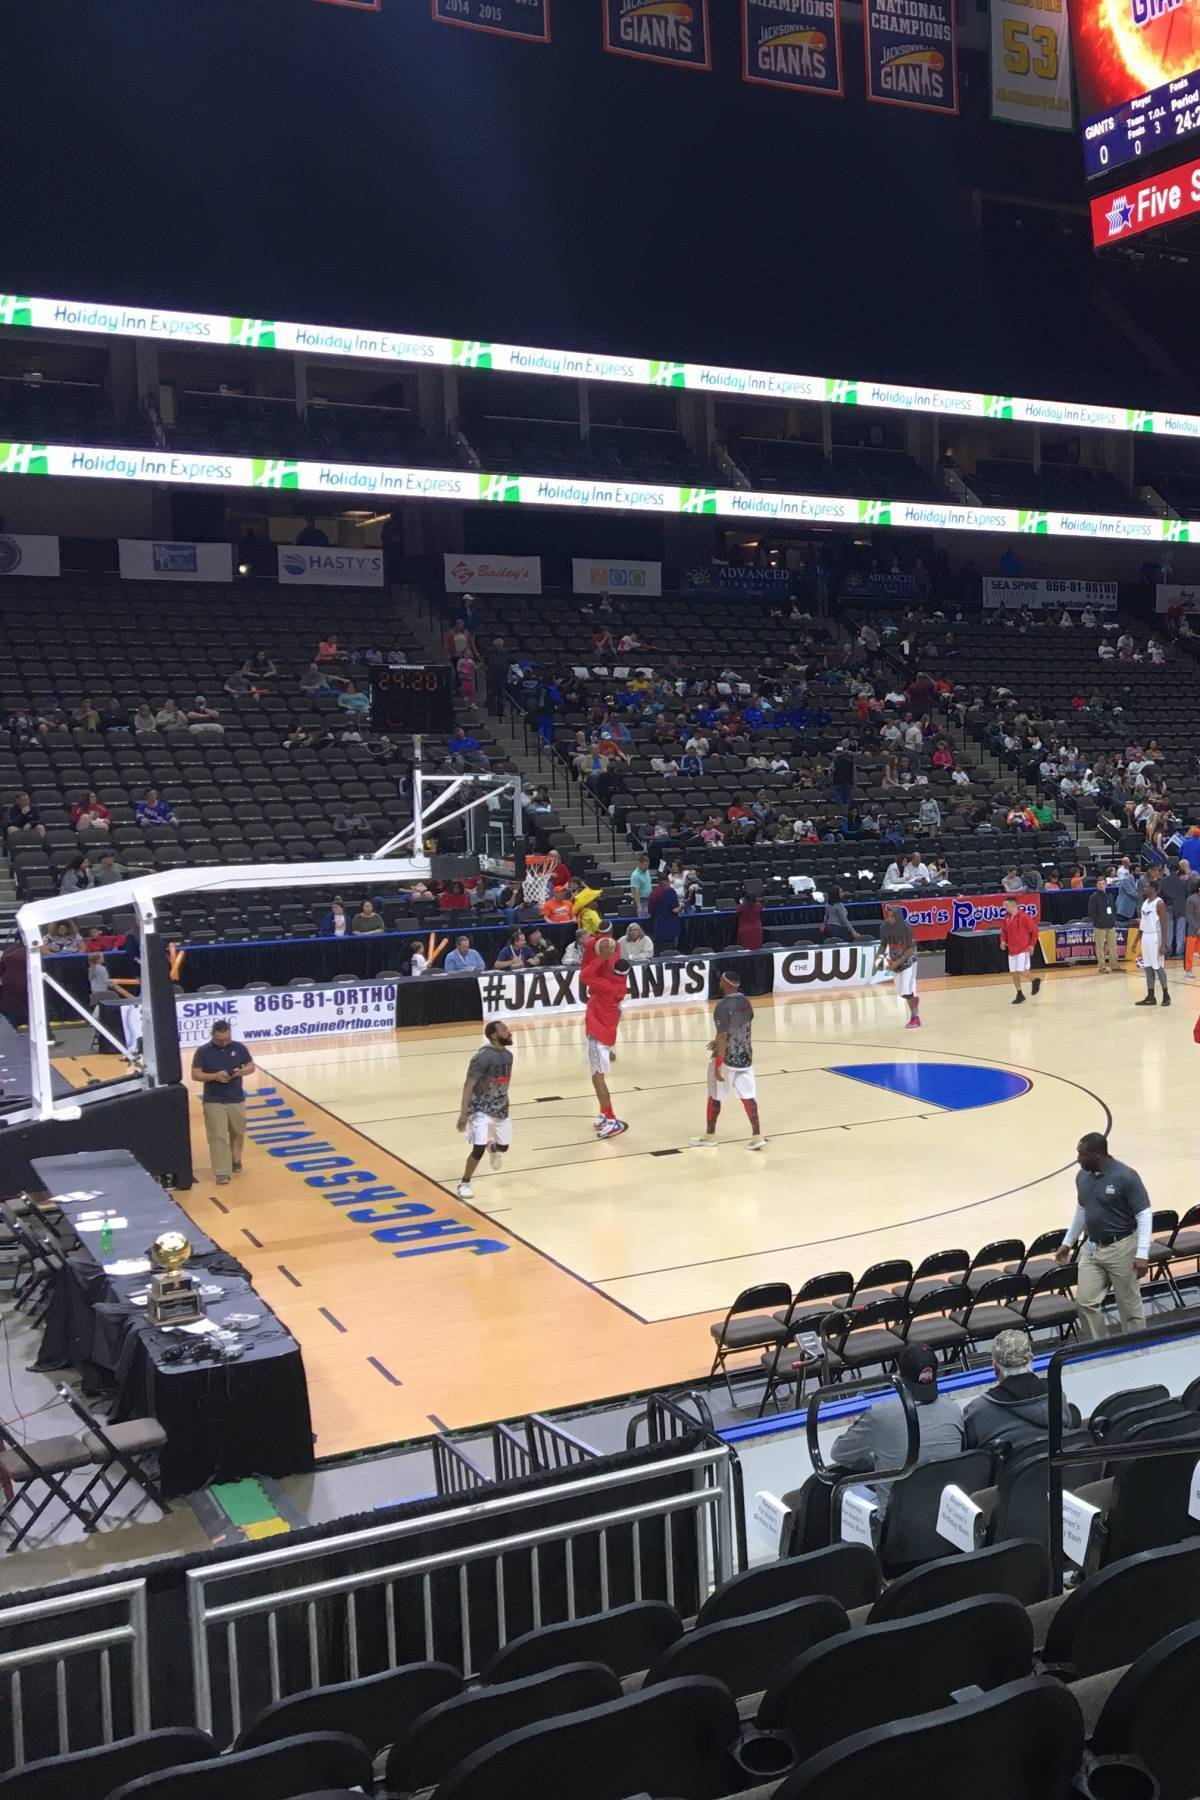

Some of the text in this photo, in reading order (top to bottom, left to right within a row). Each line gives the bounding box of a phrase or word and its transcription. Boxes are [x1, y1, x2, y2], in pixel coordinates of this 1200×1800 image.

[480, 4, 502, 21] 2015
[871, 13, 951, 40] CHAMPIONS
[1003, 19, 1057, 80] 53
[1131, 95, 1151, 110] Player
[1169, 79, 1188, 92] Fouls
[1171, 92, 1199, 111] Period
[1085, 117, 1115, 140] GIANTS
[1127, 114, 1145, 128] Team
[1155, 121, 1161, 134] 3
[1128, 127, 1145, 140] Fouls
[1100, 145, 1109, 165] 0
[1134, 140, 1142, 155] 0
[1137, 185, 1182, 222] Five
[54, 306, 211, 336] Holiday Inn Express
[296, 329, 435, 357] Holiday Inn Express
[511, 351, 635, 376] Holiday Inn Express
[701, 370, 813, 394] Holiday Inn Express
[871, 388, 972, 410] Holiday Inn Express
[1025, 404, 1117, 425] Holiday Inn Express
[1165, 418, 1199, 434] Holiday
[72, 452, 233, 480] Holiday Inn Express
[320, 468, 461, 493] Holiday Inn Express
[538, 483, 665, 506] Holiday Inn Express
[732, 496, 845, 518] Holiday Inn Express
[905, 507, 1007, 527] Holiday Inn Express
[1060, 517, 1153, 536] Holiday Inn Express
[309, 554, 381, 571] HASTY'S
[718, 568, 790, 580] ADVANCED
[992, 580, 1010, 590] SEA
[1012, 580, 1039, 591] SPINE
[782, 947, 858, 985] CW
[183, 985, 396, 1017] SPINE 866-81-ORTHO
